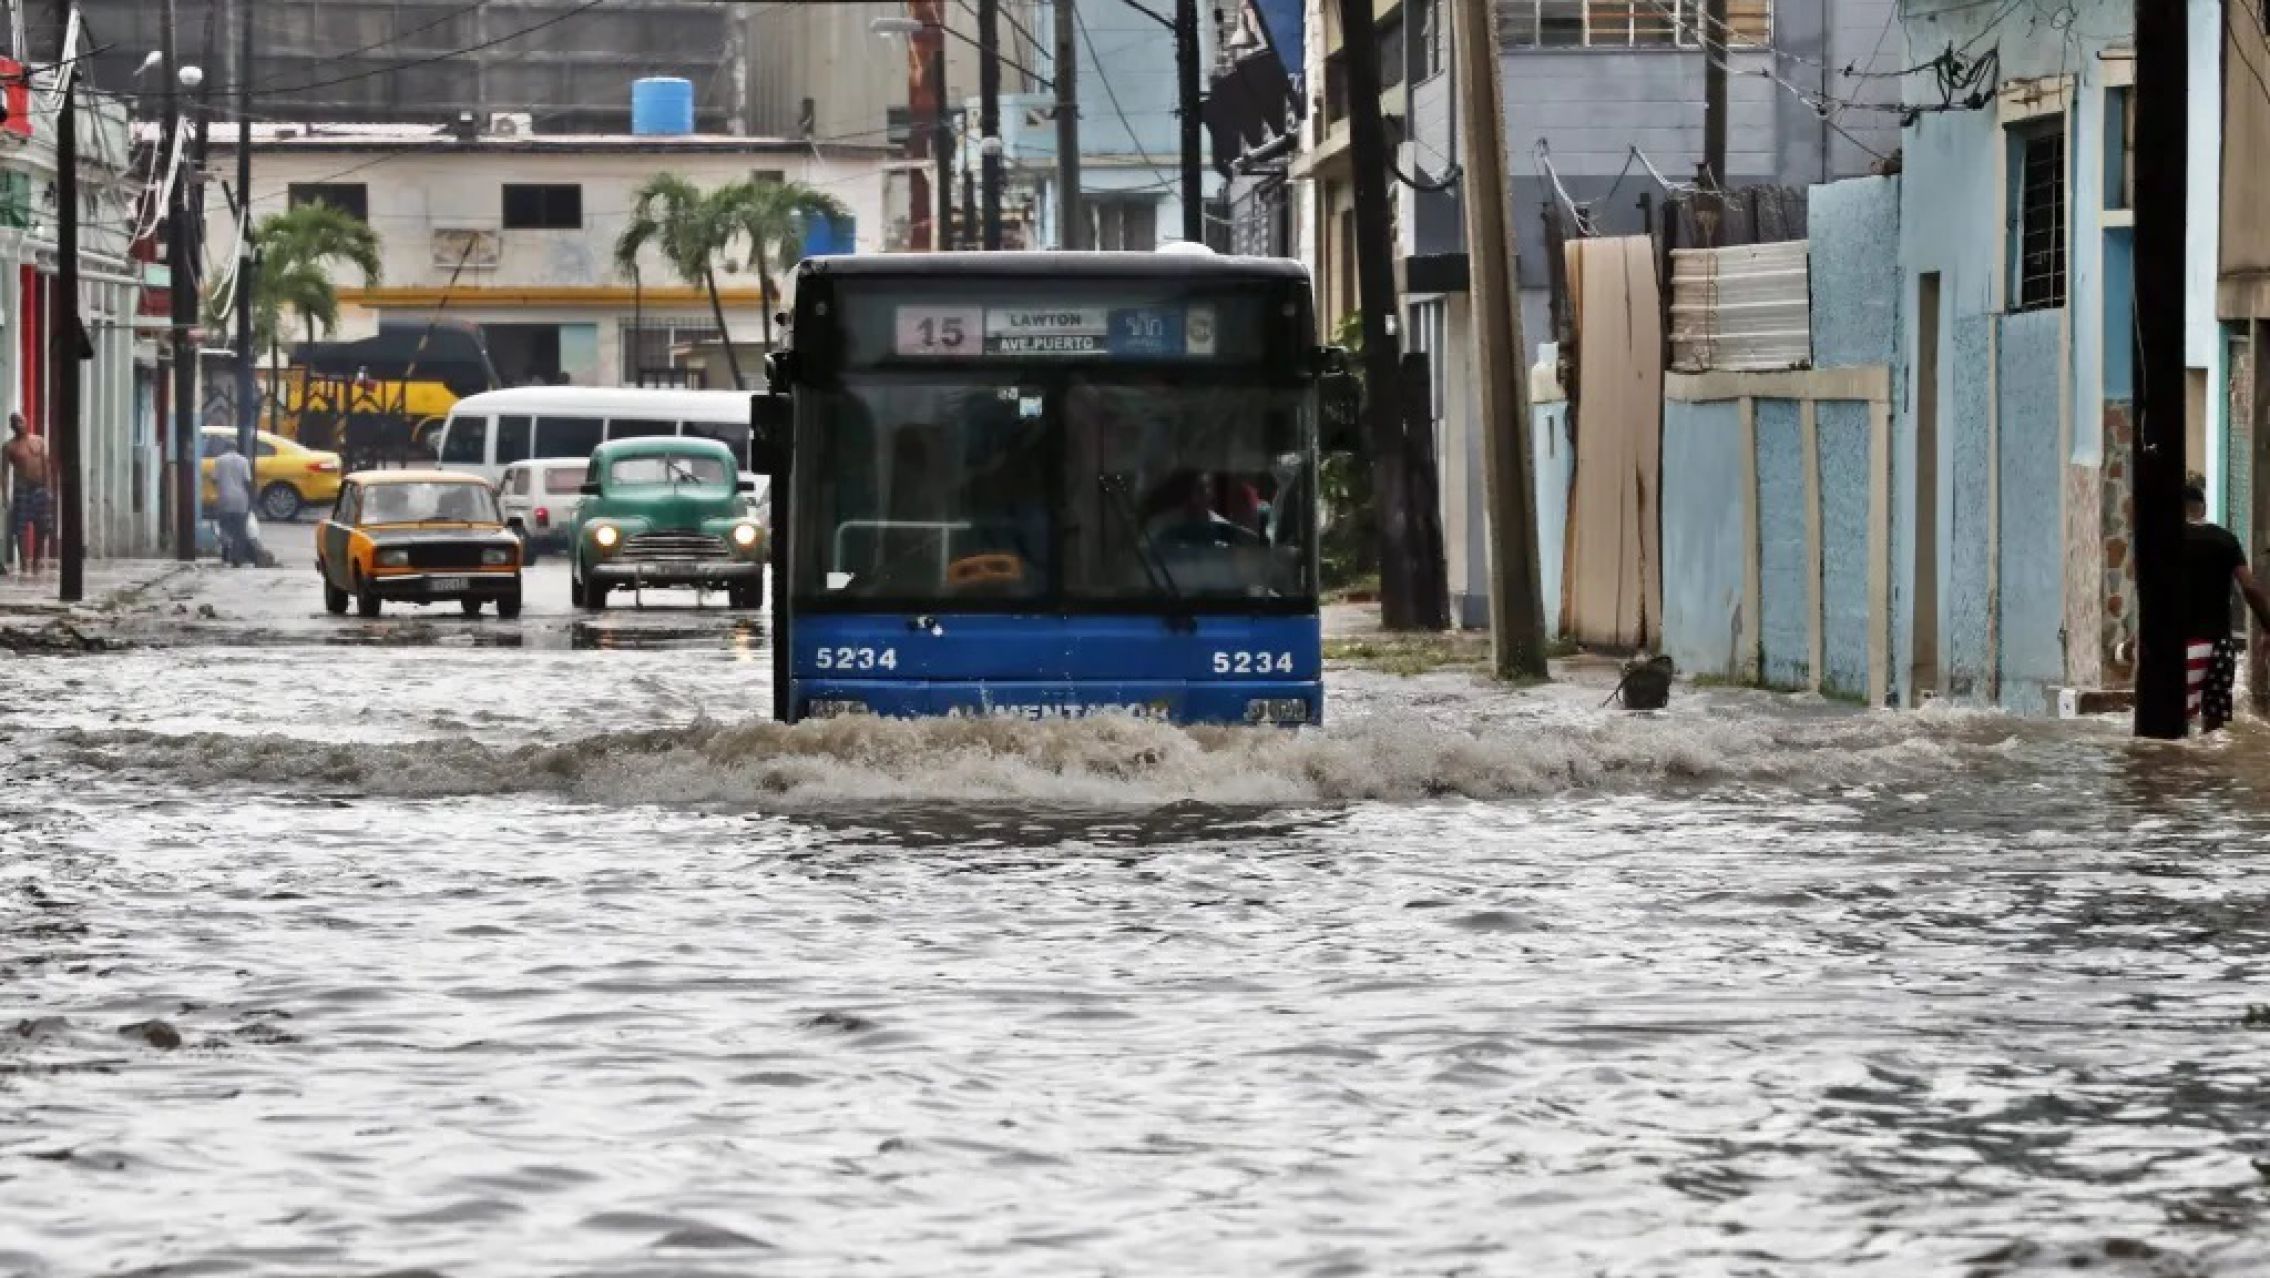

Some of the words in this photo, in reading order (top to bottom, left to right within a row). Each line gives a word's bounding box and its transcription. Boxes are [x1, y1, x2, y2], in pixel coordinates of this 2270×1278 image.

[915, 316, 965, 347] 15
[1010, 313, 1082, 327] LAWTON
[816, 647, 897, 671] 5234
[1213, 651, 1293, 673] 5234
